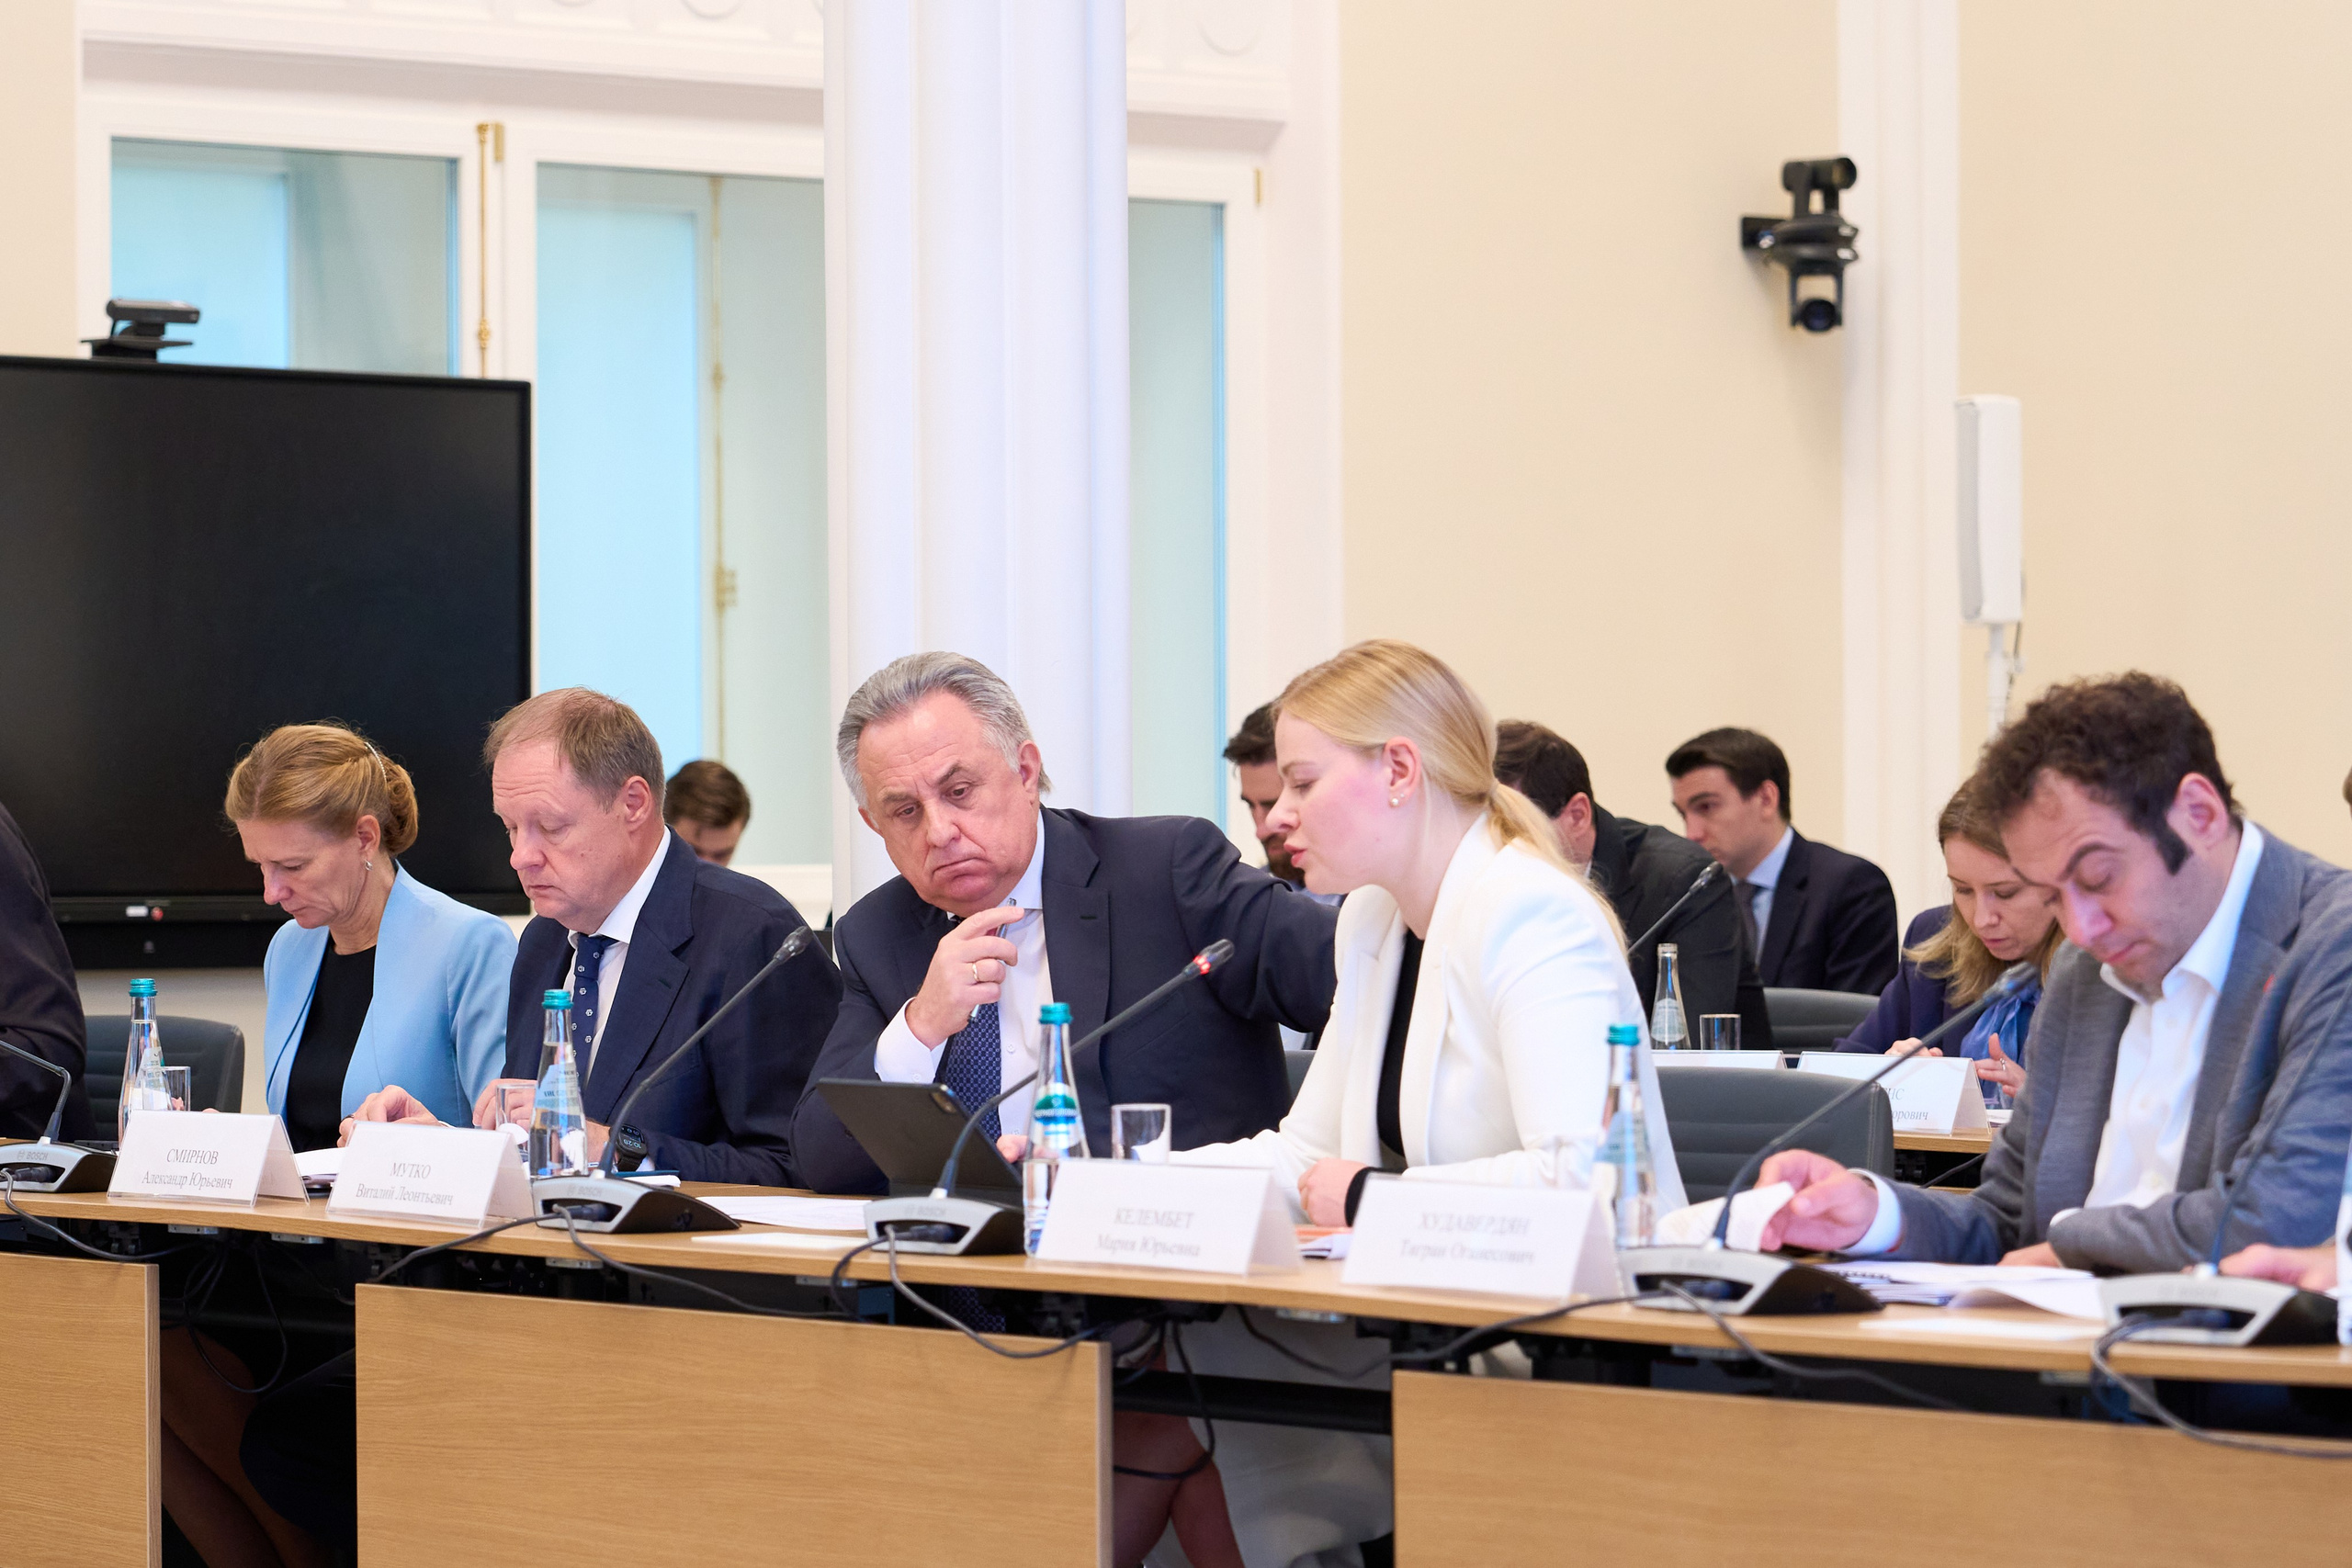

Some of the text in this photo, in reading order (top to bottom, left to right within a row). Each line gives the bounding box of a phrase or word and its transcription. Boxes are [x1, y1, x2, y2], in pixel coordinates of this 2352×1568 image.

[1892, 1110, 1928, 1122] орович
[27, 1151, 49, 1161] BOSCH
[166, 1148, 219, 1165] СМИРНОВ
[390, 1162, 432, 1179] МУТКО
[141, 1170, 233, 1190] Александр Юрьевич
[356, 1183, 454, 1206] Виталий Леонтьевич
[1114, 1207, 1194, 1229] КЕЛЕМБЕТ
